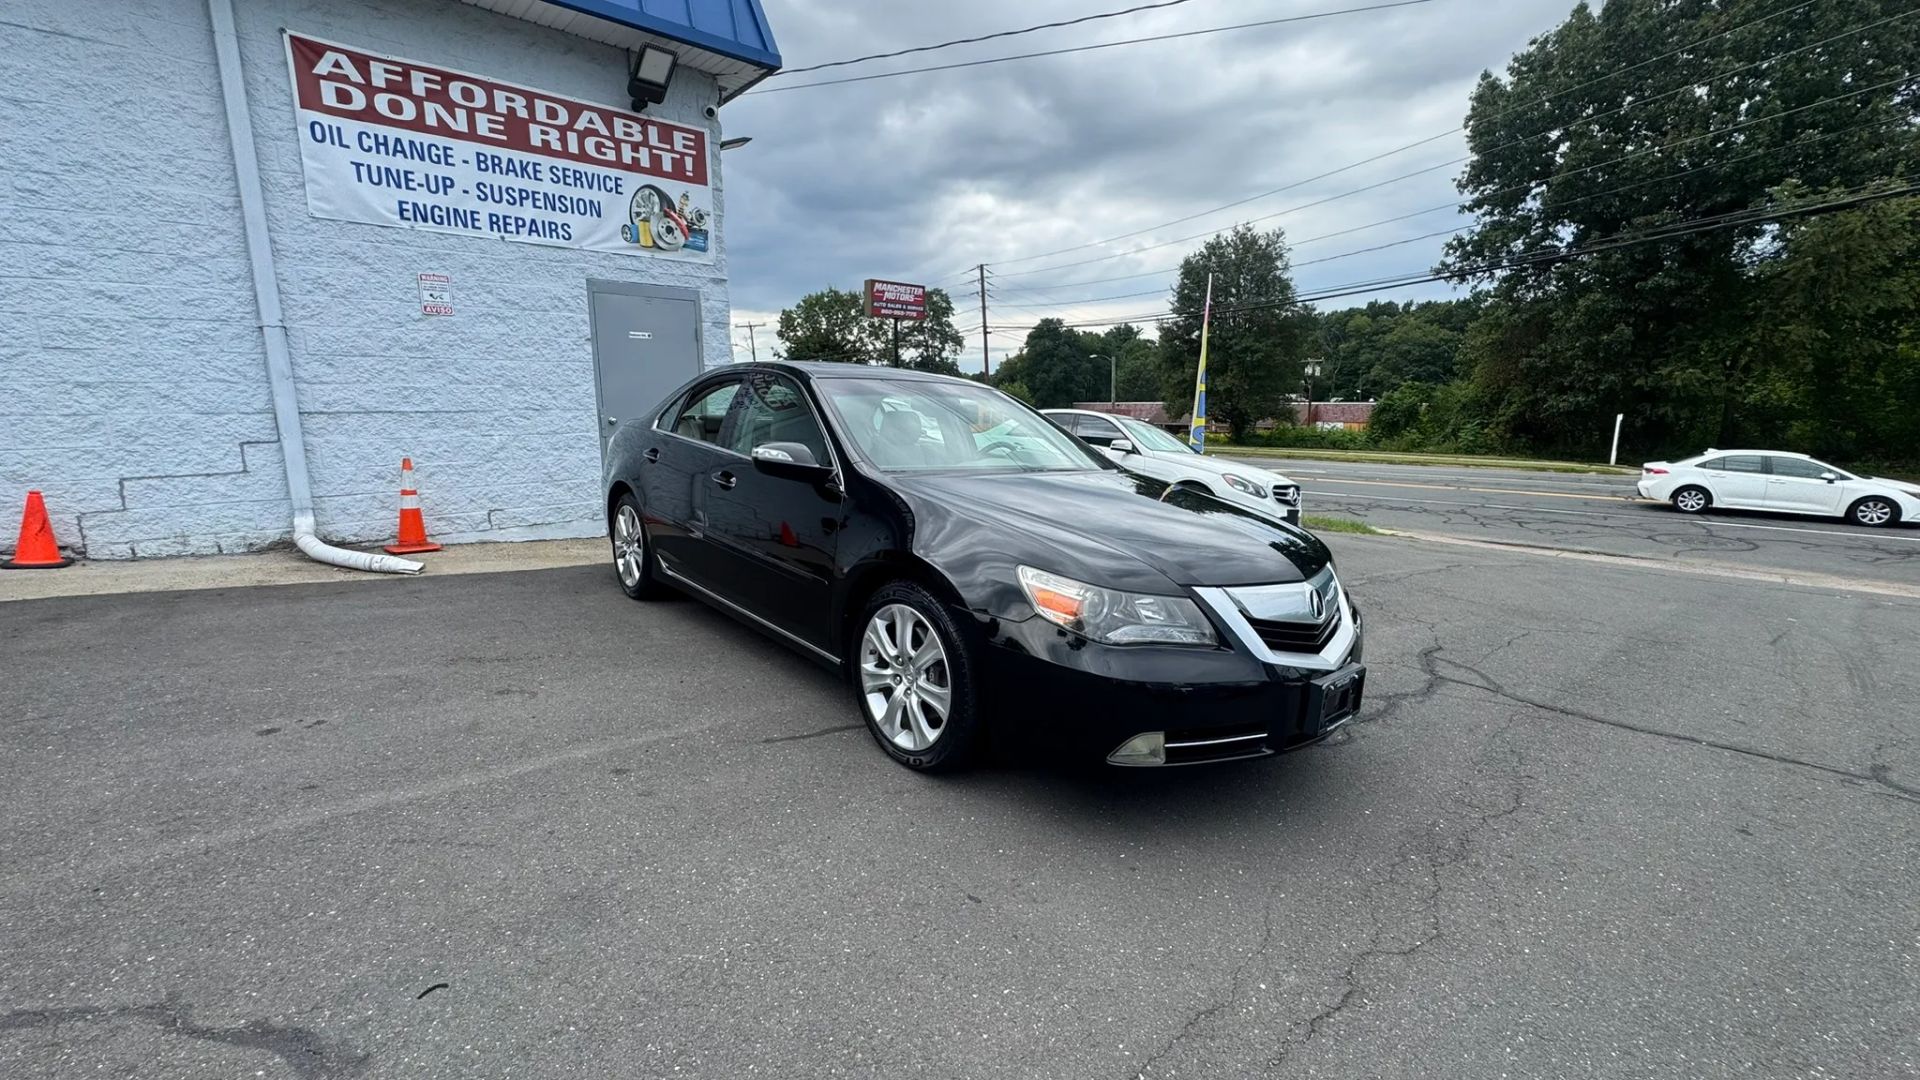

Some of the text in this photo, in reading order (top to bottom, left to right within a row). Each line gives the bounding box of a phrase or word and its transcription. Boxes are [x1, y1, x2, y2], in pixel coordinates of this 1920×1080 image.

[312, 50, 697, 154] AFFORDABLE
[320, 79, 695, 177] DONE RIGHT!
[309, 120, 351, 150] OIL
[357, 131, 457, 168] CHANGE
[475, 152, 543, 181] BRAKE
[549, 167, 624, 195] SERVICE
[350, 161, 455, 197] TUNE-UP
[475, 182, 602, 219] SUSPENSION
[398, 200, 572, 241] ENGINE REPAIRS
[426, 306, 452, 314] AVISO
[874, 282, 923, 295] MANCHESTER
[883, 292, 914, 302] MOTORS
